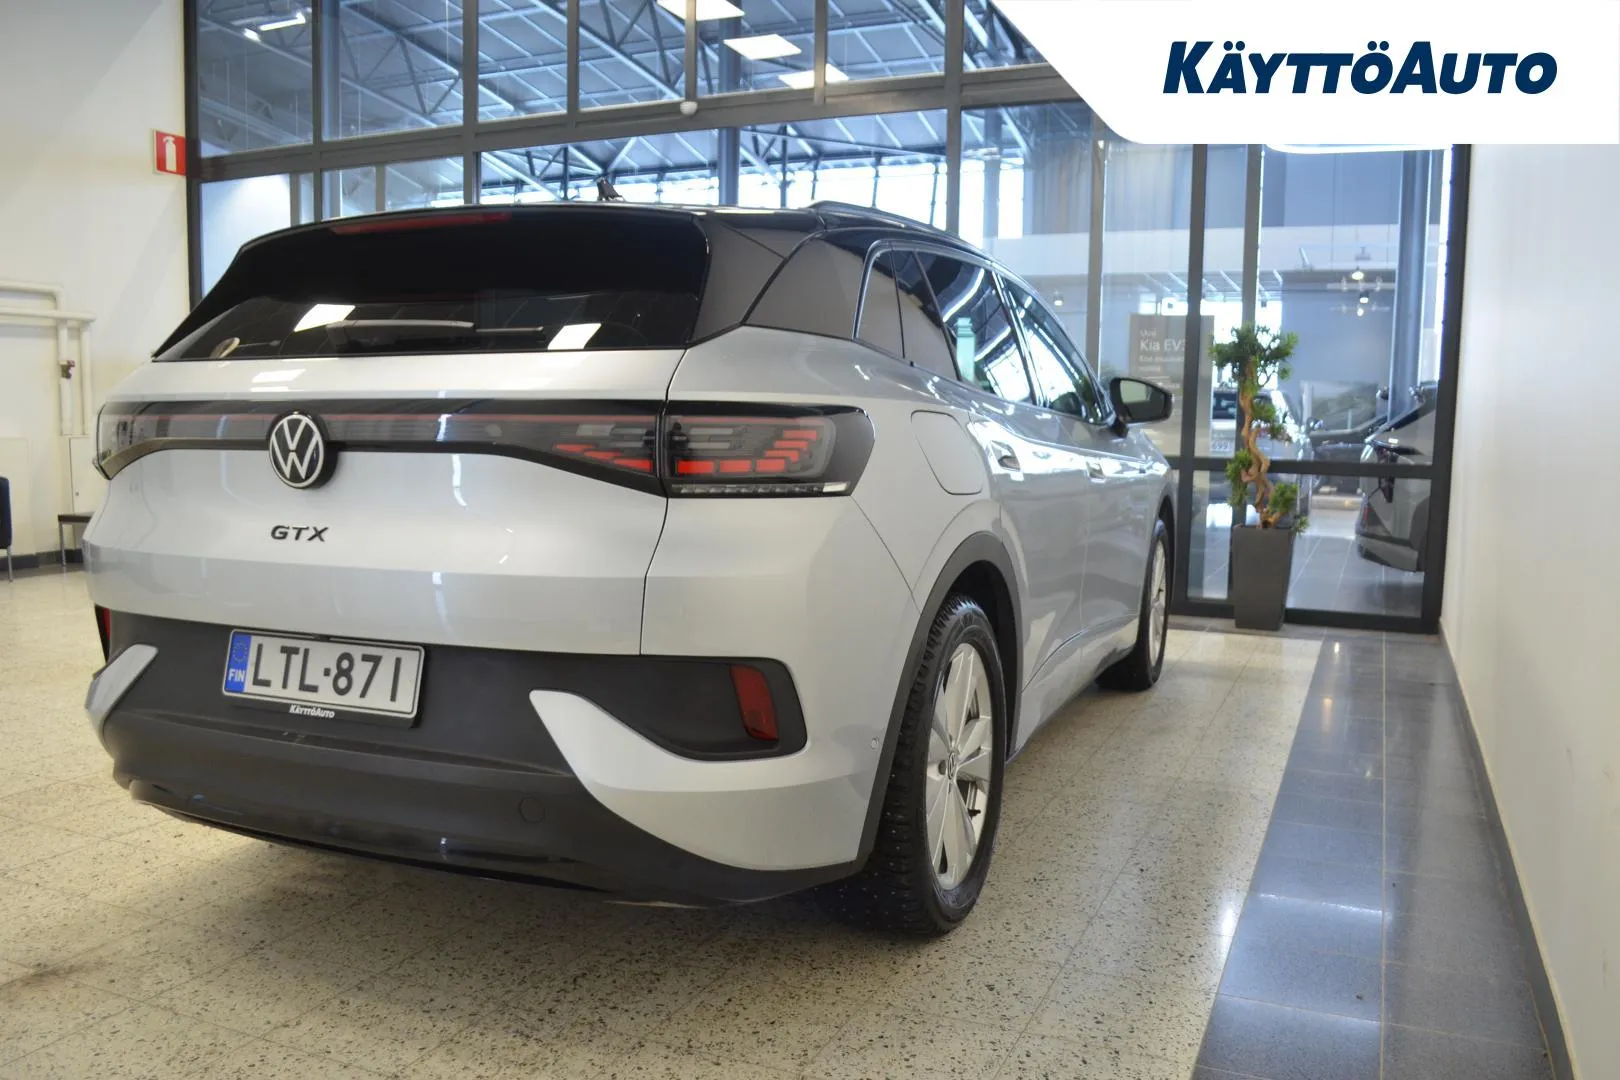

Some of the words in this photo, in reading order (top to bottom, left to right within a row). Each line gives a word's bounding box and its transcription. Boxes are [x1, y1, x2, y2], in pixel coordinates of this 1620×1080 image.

[1140, 339, 1160, 351] Kia
[270, 525, 329, 542] GTX
[228, 668, 246, 682] FIN
[252, 643, 402, 702] LTL-871
